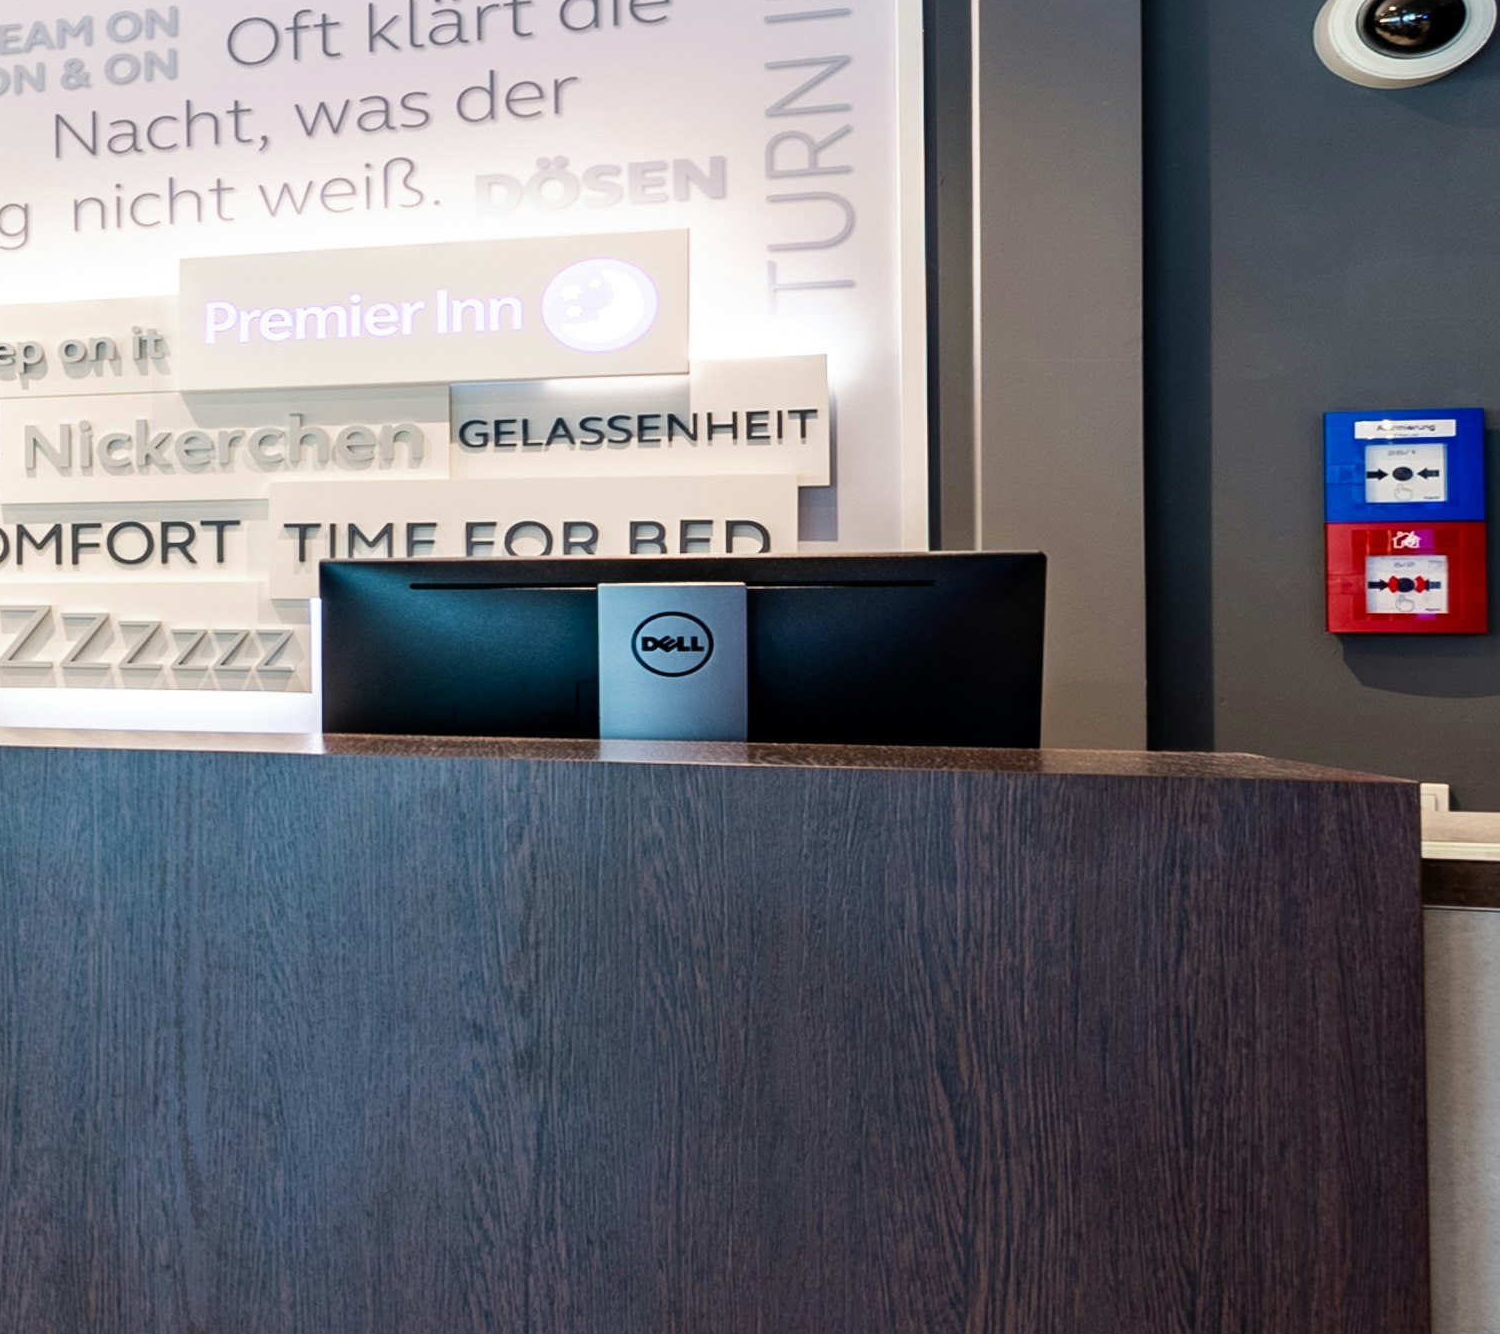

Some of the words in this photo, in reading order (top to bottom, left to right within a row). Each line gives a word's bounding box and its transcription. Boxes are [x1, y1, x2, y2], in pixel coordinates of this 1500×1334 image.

[106, 5, 179, 44] ON
[227, 8, 342, 67] Oft
[60, 59, 91, 90] &
[104, 48, 179, 86] ON
[54, 99, 270, 160] Nacht,
[295, 89, 431, 138] was
[456, 69, 579, 123] der
[73, 177, 235, 233] nicht
[259, 157, 441, 217] weiß.
[474, 155, 727, 215] DÖSEN
[764, 54, 856, 315] TURN
[204, 293, 424, 344] Premier
[436, 289, 524, 334] Inn
[58, 332, 116, 363] on
[132, 326, 164, 361] it
[24, 412, 425, 473] Nickerchen
[458, 409, 818, 448] GELASSENHEIT
[284, 521, 438, 563] TIME
[465, 520, 600, 556] FOR
[629, 519, 771, 555] BED
[640, 635, 705, 653] DELL
